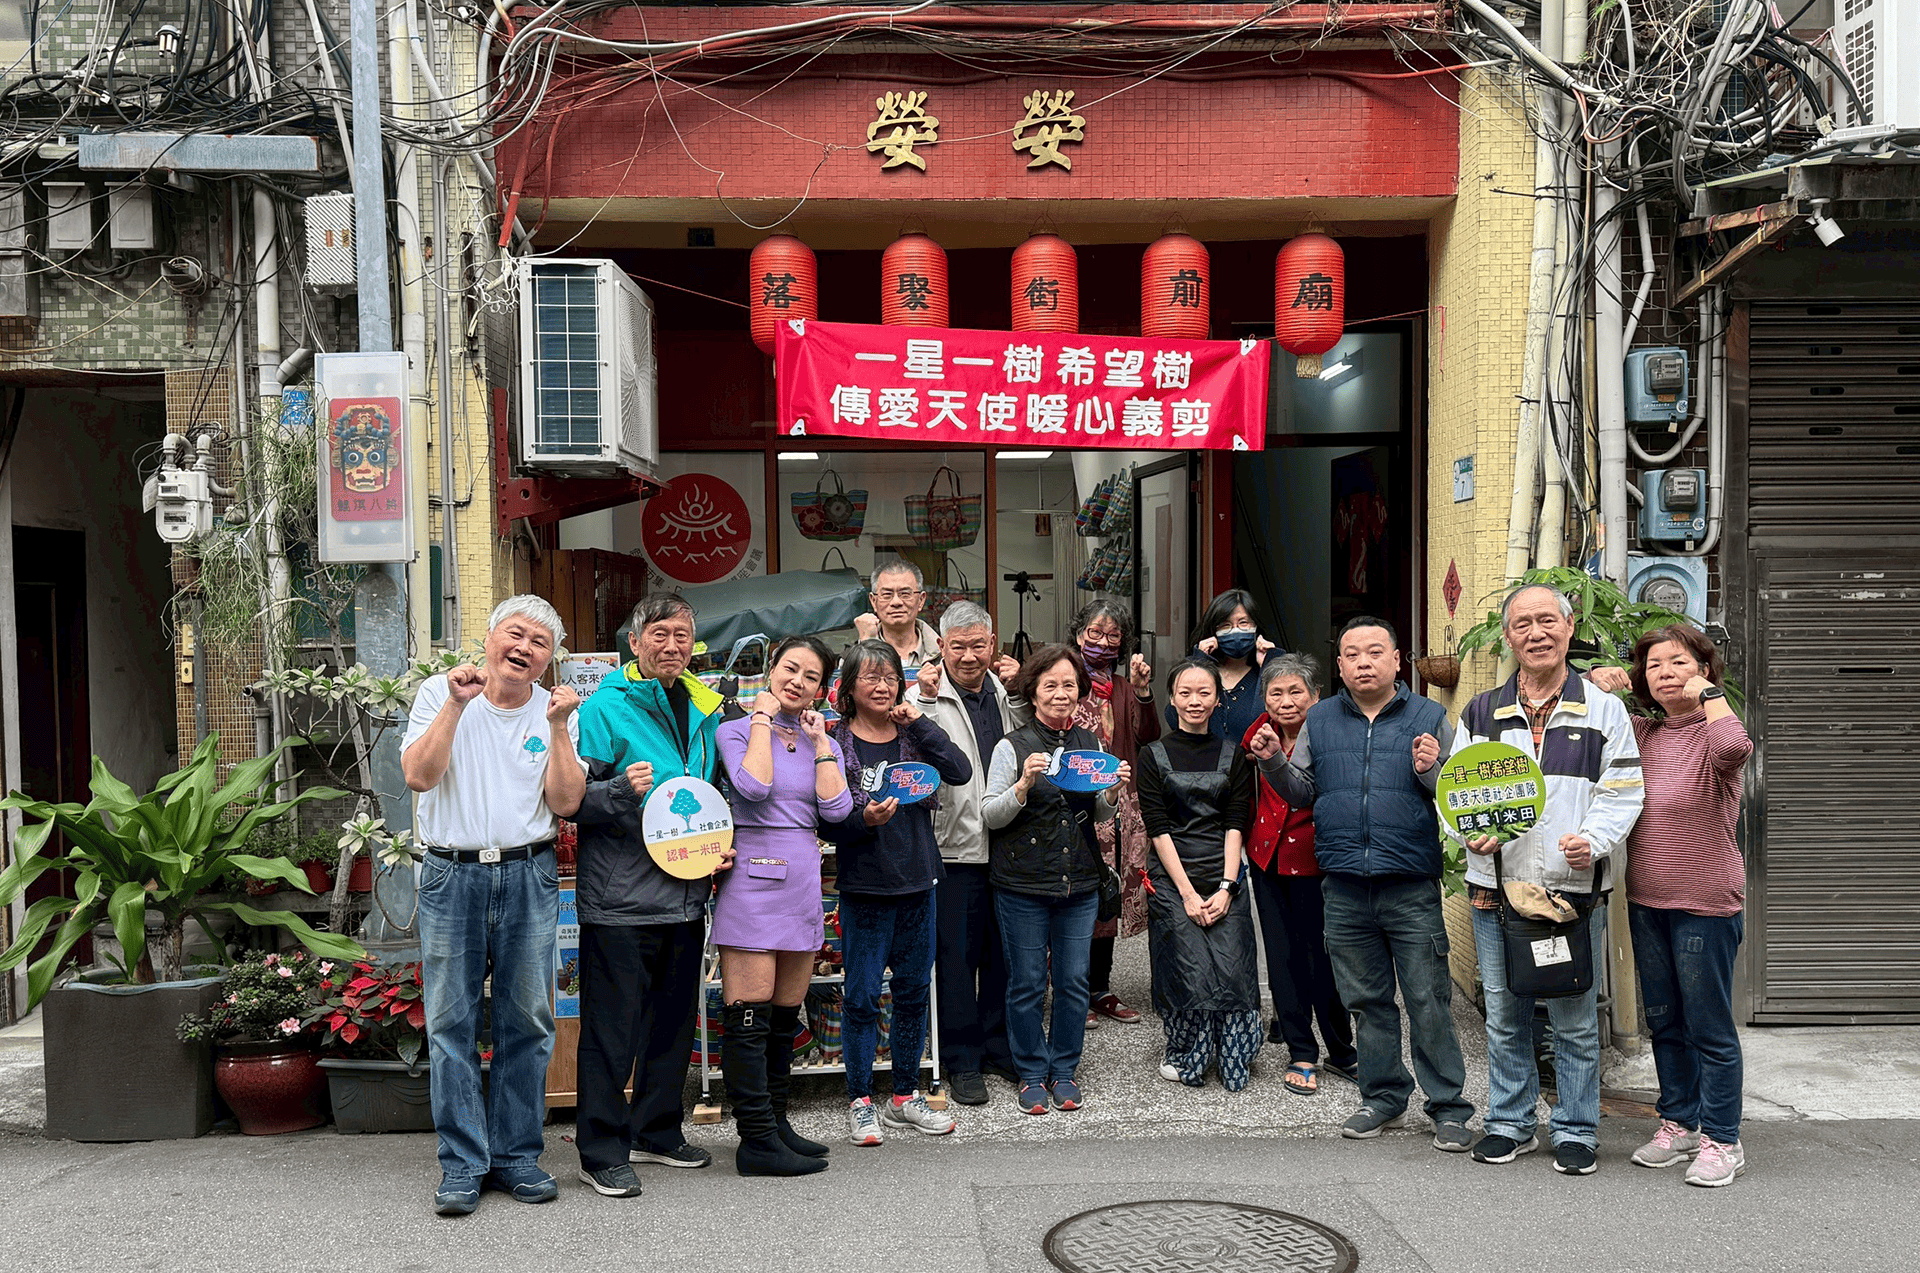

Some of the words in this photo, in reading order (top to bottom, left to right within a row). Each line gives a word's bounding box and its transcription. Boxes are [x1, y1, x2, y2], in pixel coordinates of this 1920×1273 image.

[829, 384, 1212, 437] 傳愛天使暖心義剪
[1441, 754, 1530, 784] 一星一樹希望樹
[1447, 780, 1538, 810] 傳愛天使社企團隊
[1458, 806, 1535, 830] 認養1米田
[666, 841, 721, 863] 認養一米田
